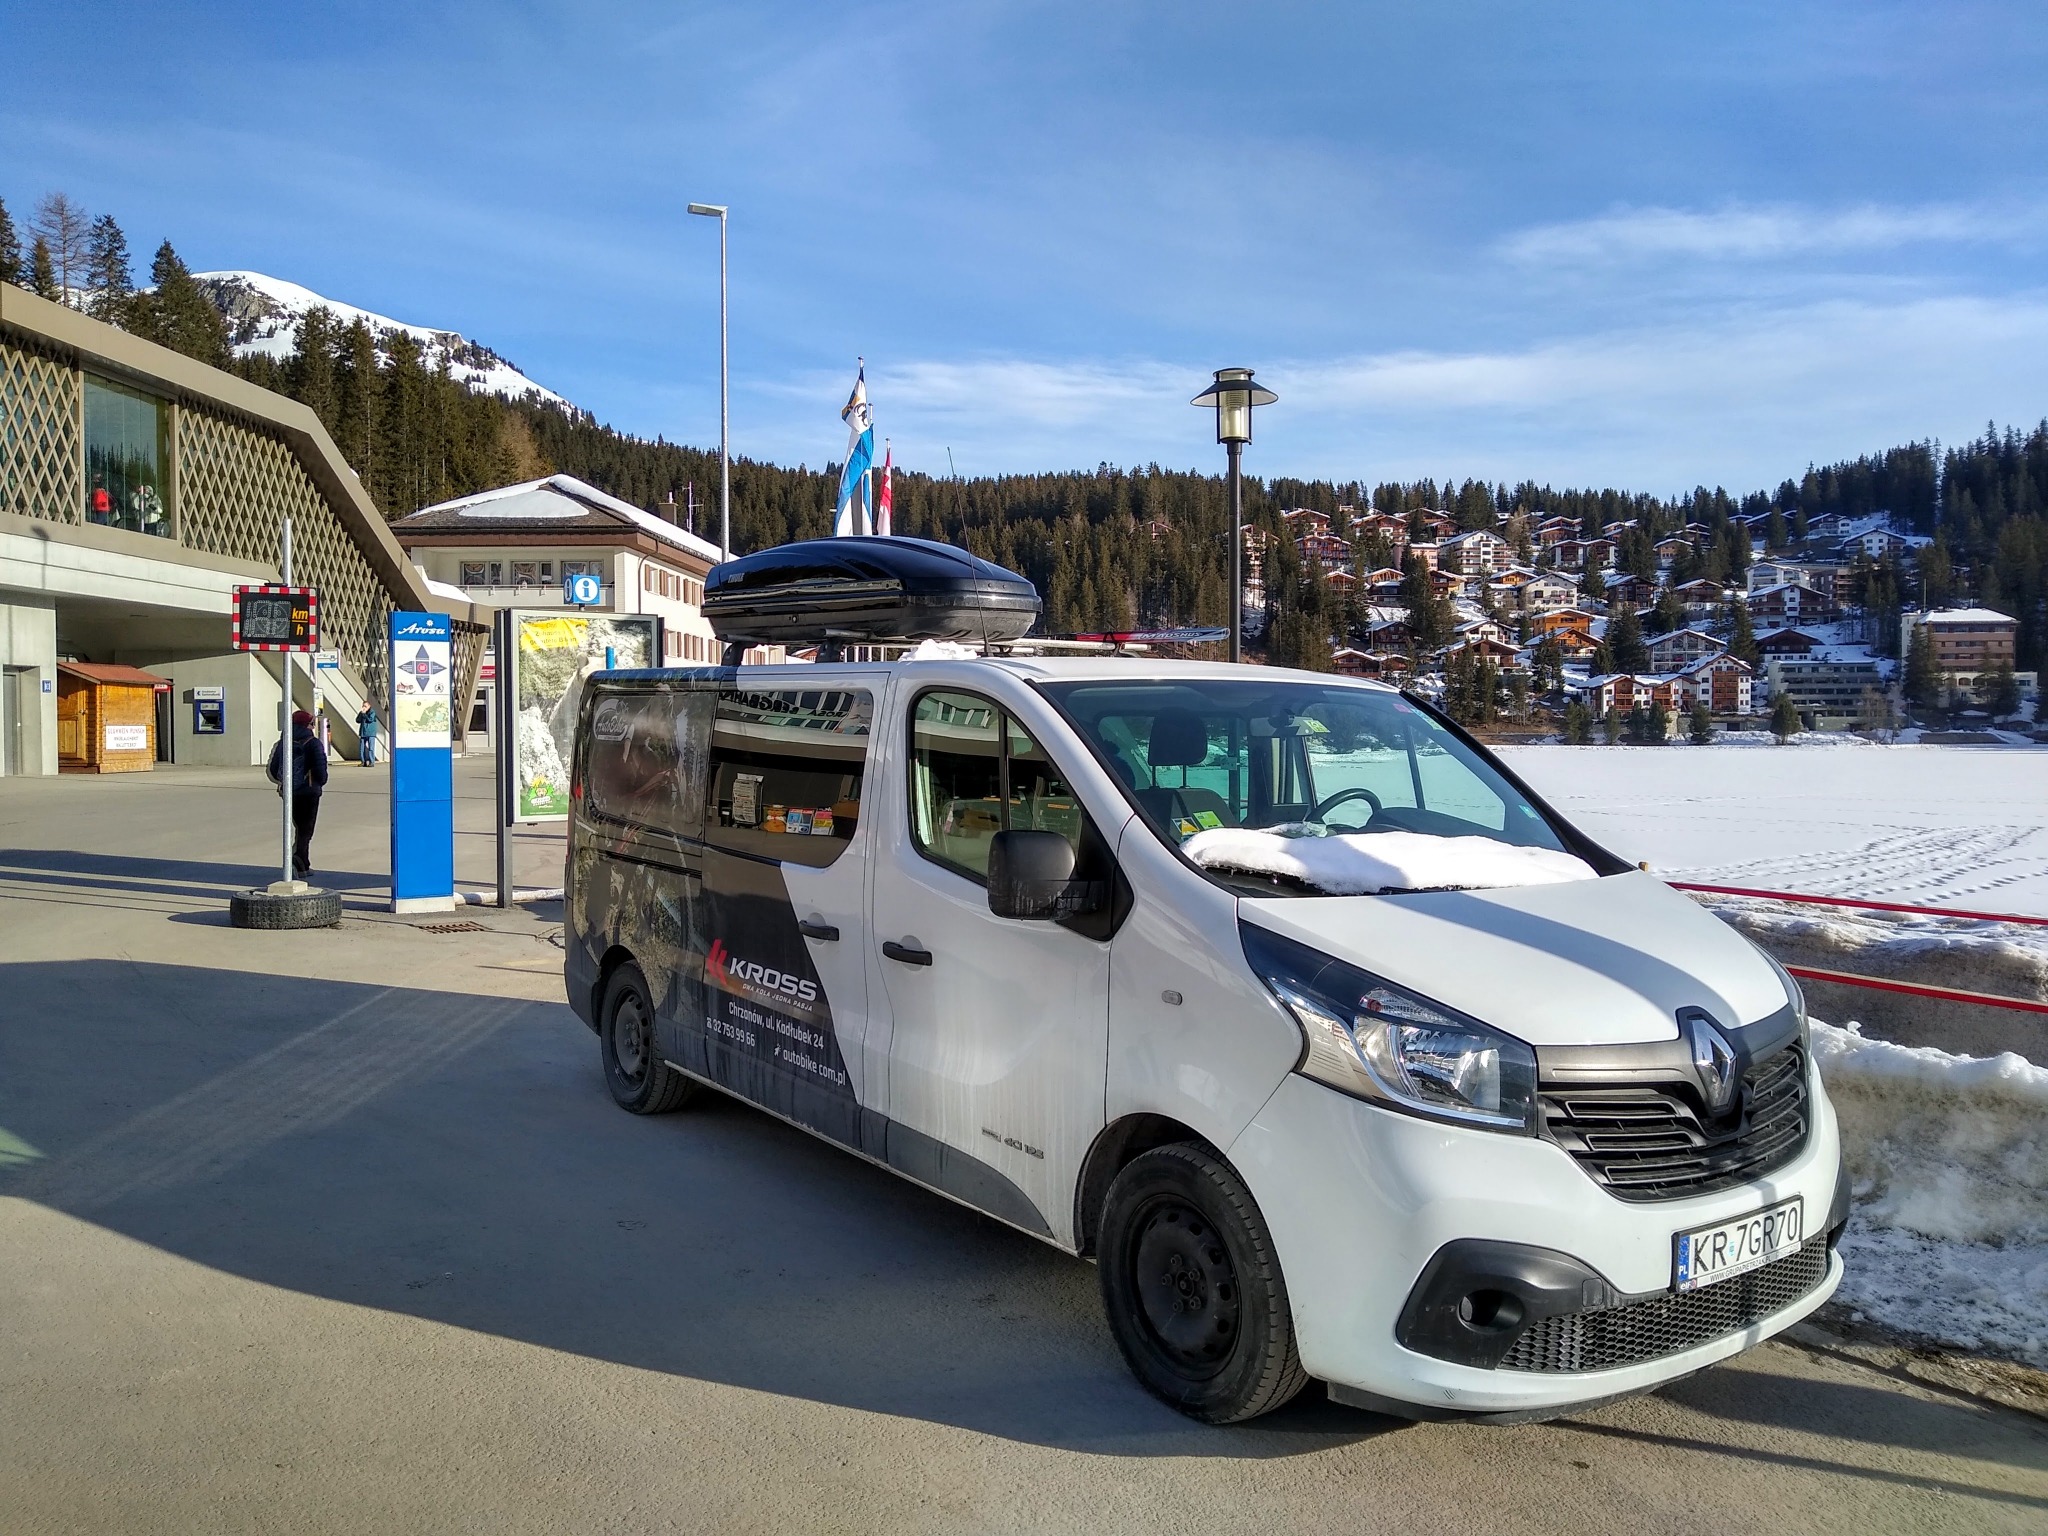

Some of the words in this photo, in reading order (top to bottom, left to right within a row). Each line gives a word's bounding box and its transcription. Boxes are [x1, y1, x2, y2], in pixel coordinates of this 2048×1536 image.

[728, 573, 745, 583] THULE
[292, 608, 308, 620] km
[296, 624, 304, 636] h
[397, 622, 446, 635] Arosa
[730, 957, 817, 1001] KROSS
[742, 983, 755, 992] DWA
[771, 993, 792, 1005] JEDNA
[792, 1000, 813, 1012] PASJA
[728, 1001, 765, 1028] Chrzanów,
[765, 1015, 775, 1031] ul.
[775, 1018, 812, 1046] Kadłubek
[813, 1033, 824, 1050] 24
[713, 1018, 722, 1034] 32
[722, 1022, 735, 1039] 753
[735, 1028, 745, 1043] 99
[745, 1032, 756, 1047] 66
[1693, 1230, 1728, 1275] KR
[1736, 1206, 1798, 1262] 7GR70
[1679, 1264, 1688, 1276] PL
[1680, 1280, 1692, 1290] elf
